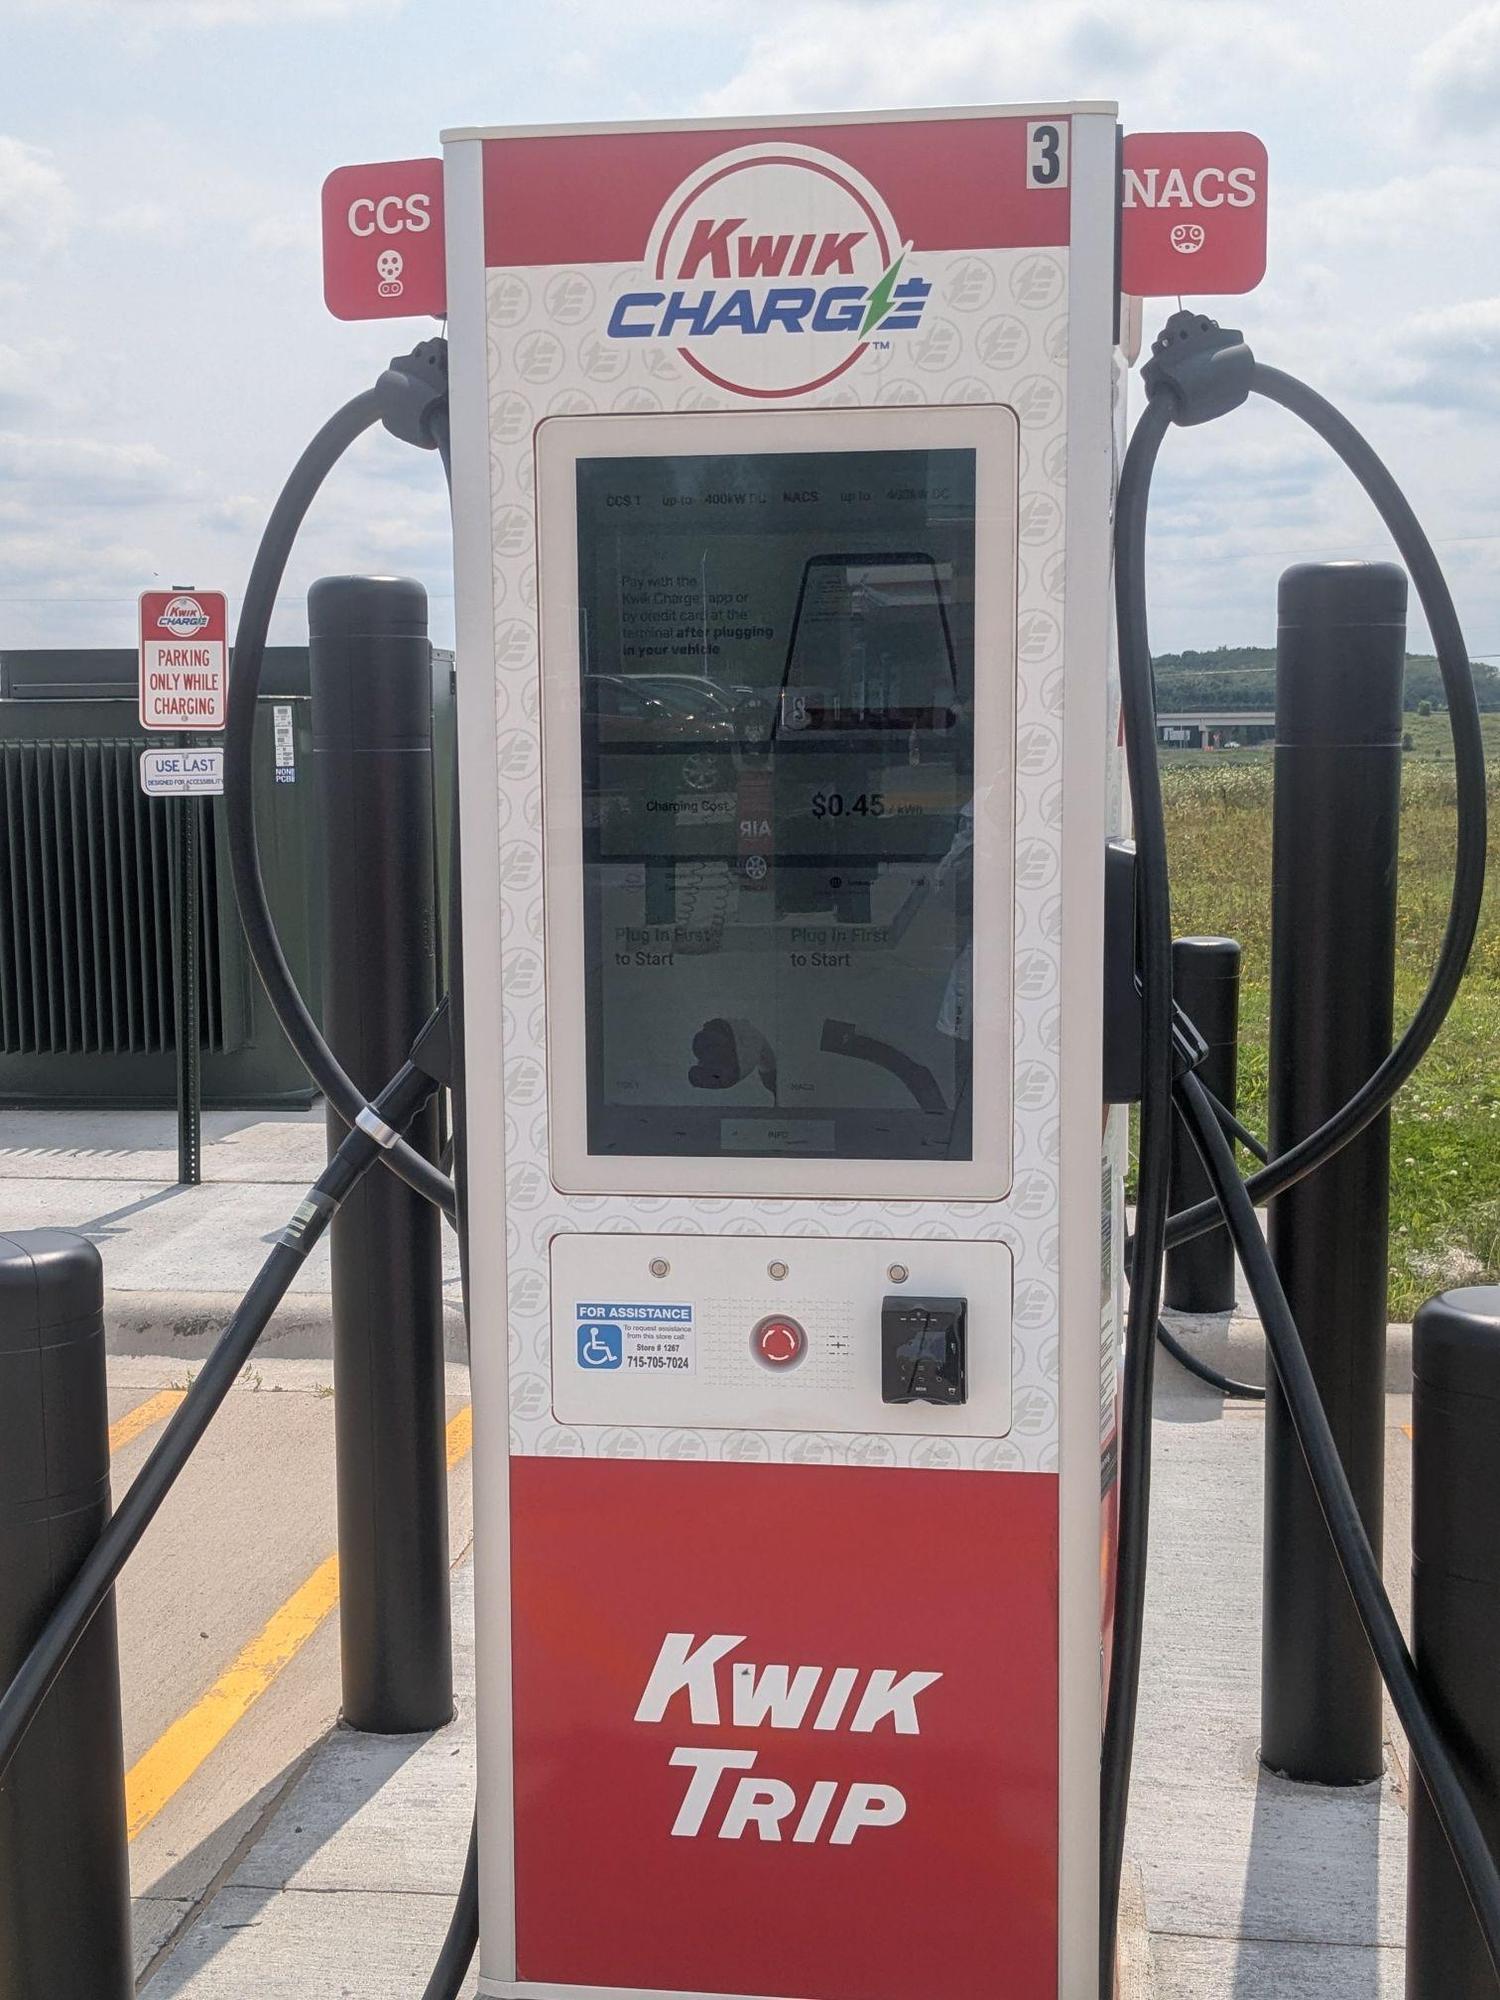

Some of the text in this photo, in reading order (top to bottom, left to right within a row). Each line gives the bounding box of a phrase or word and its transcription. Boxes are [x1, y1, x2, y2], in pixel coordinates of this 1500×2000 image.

[1032, 125, 1060, 184] 3
[1122, 167, 1256, 208] NACS
[348, 194, 431, 237] CCS
[607, 277, 932, 339] CHARGE
[606, 495, 632, 507] CCS
[783, 491, 819, 503] NACS
[622, 576, 697, 590] Pay with the
[622, 609, 635, 623] by
[640, 608, 677, 621] credit
[710, 609, 723, 621] at
[727, 608, 748, 620] the
[676, 626, 710, 639] after
[713, 626, 774, 641] plugging
[158, 649, 210, 667] PARKING
[622, 643, 721, 658] in your vehicle
[150, 673, 219, 691] ONLY WHILE
[154, 697, 215, 715] CHARGING
[155, 759, 216, 773] USE LAST
[646, 799, 698, 813] Charging
[811, 791, 885, 820] $0.45
[615, 927, 711, 945] Plug In First
[791, 927, 889, 945] Plug In First
[615, 951, 675, 966] to Start
[790, 952, 851, 967] to Start
[580, 1306, 690, 1319] FOR ASSISTANCE
[632, 1324, 657, 1333] request
[636, 1343, 655, 1352] Store
[663, 1344, 680, 1352] 1267
[627, 1355, 689, 1369] 715-705-7024
